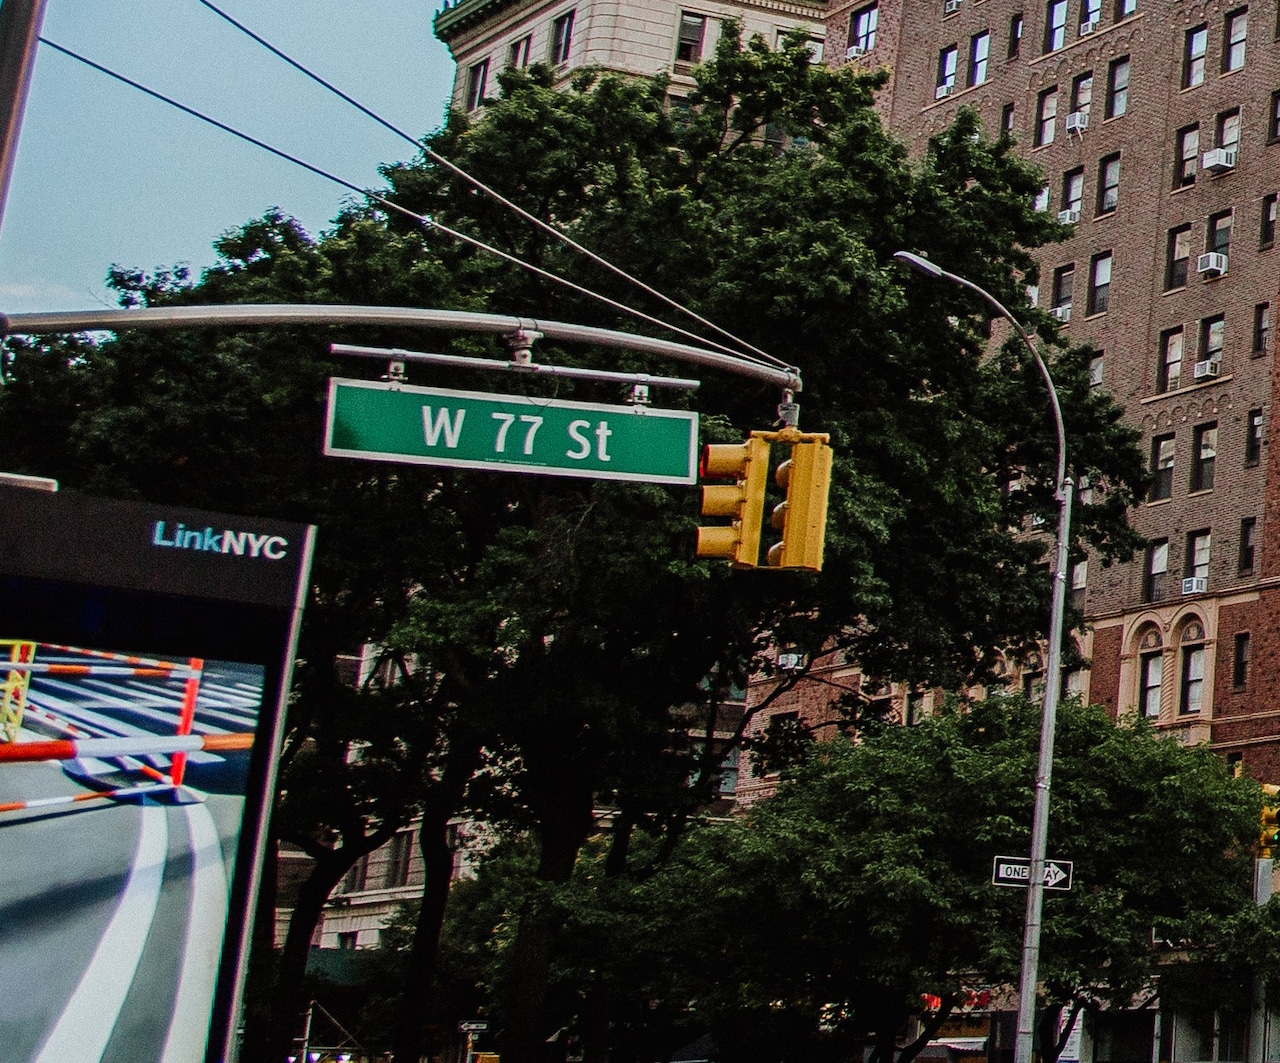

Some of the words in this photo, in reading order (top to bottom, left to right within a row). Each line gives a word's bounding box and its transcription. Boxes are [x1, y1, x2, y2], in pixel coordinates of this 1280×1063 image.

[421, 405, 466, 448] W
[491, 412, 544, 455] 77
[566, 419, 613, 461] St
[153, 520, 288, 560] LinkNYC
[1005, 866, 1027, 878] ONE
[1045, 869, 1060, 880] AY
